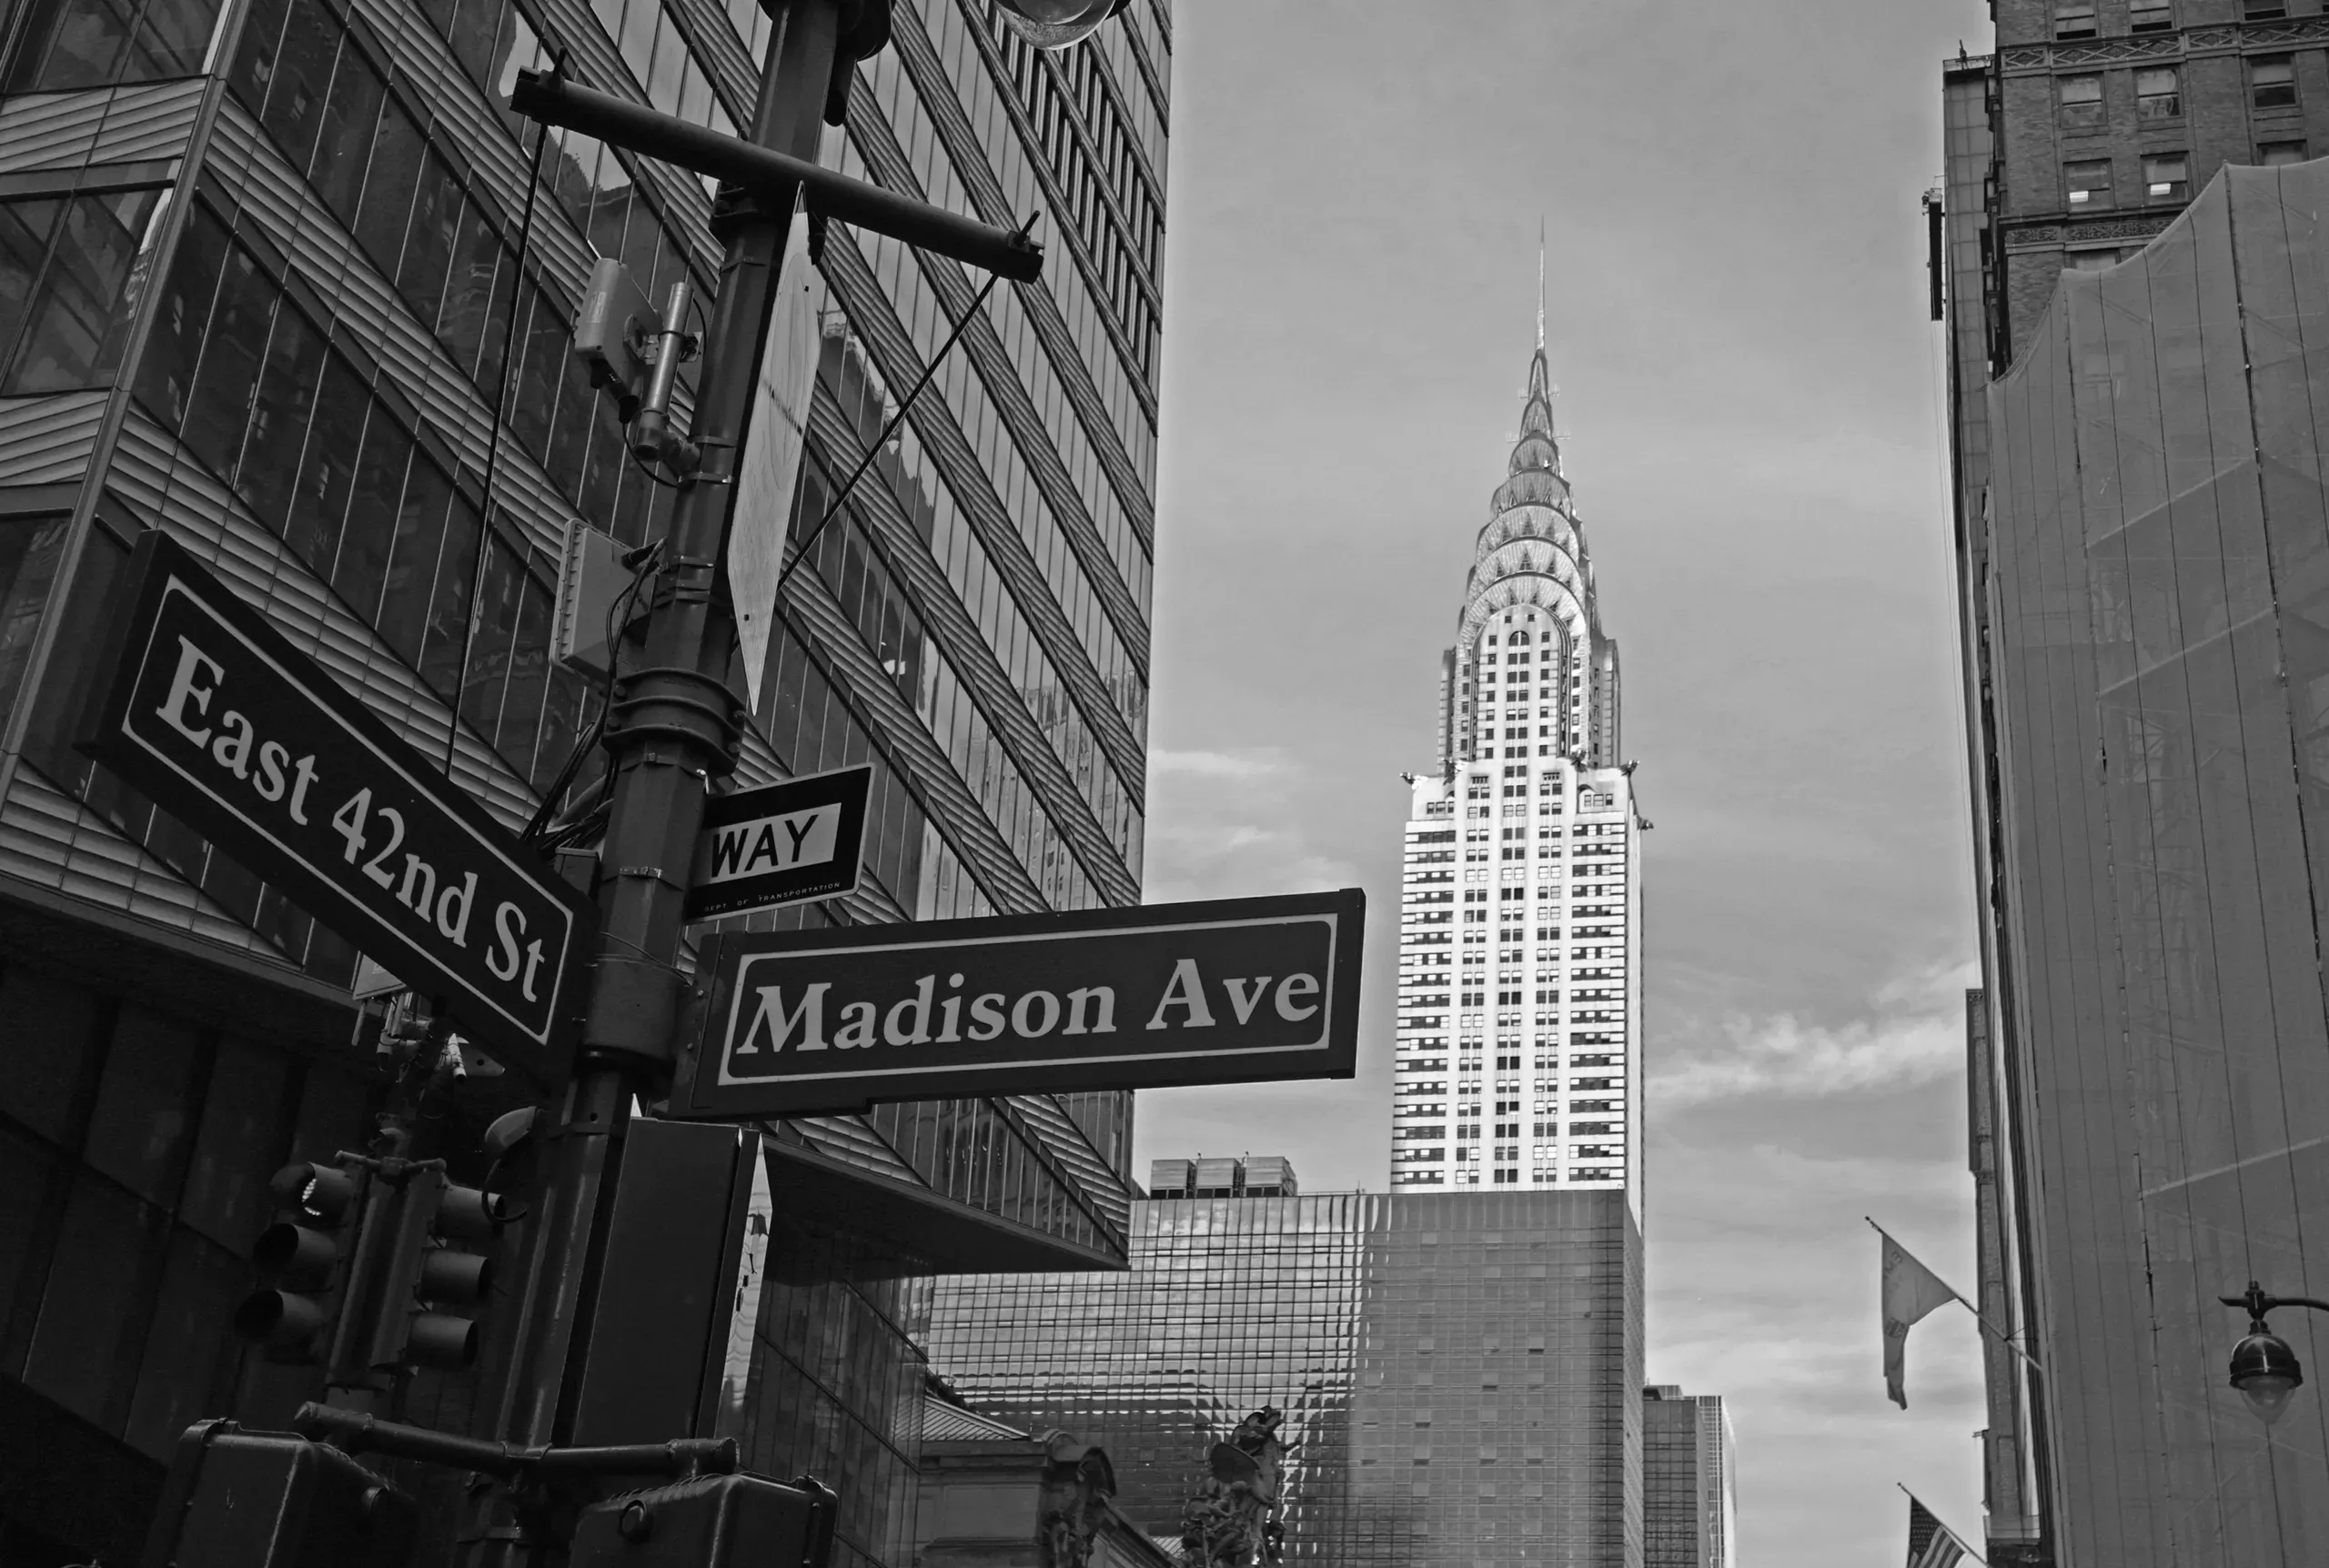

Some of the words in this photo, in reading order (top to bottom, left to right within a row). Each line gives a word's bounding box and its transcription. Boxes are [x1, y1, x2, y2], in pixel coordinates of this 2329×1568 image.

[156, 634, 319, 826] East
[331, 787, 479, 949] 42nd
[485, 900, 545, 1003] St
[711, 814, 819, 879] WAY
[704, 903, 728, 912] DEPT
[737, 899, 750, 907] OF
[758, 881, 842, 902] TRANSPORTATION
[736, 971, 1117, 1054] Madison
[1145, 958, 1320, 1030] Ave
